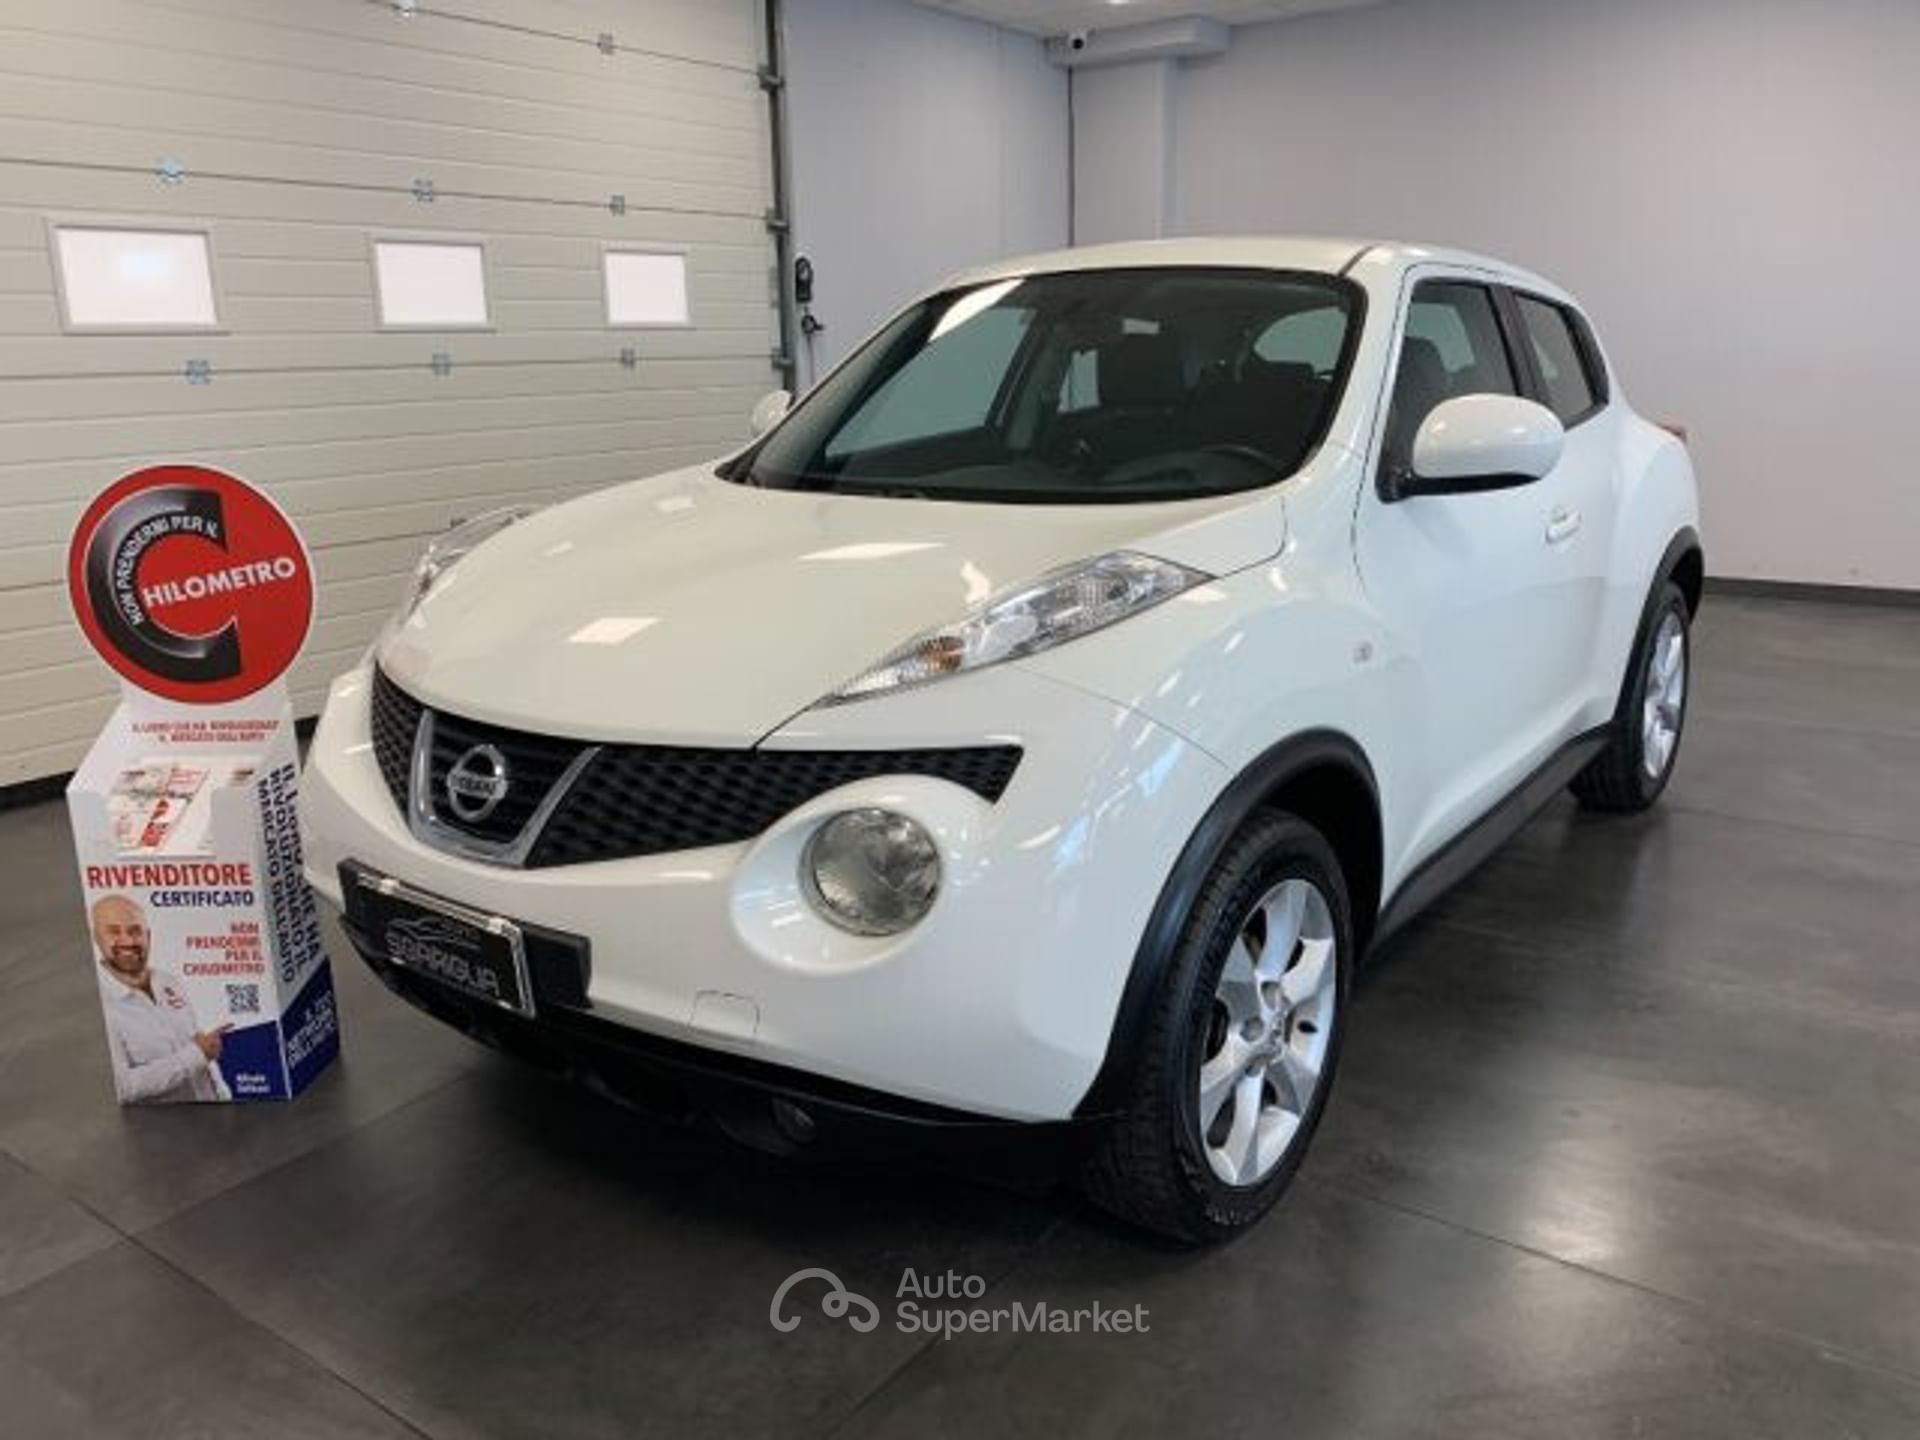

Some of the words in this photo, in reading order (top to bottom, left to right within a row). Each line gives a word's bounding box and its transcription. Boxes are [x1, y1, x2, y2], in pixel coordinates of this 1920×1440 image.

[170, 515, 202, 532] PER
[143, 556, 297, 608] HILOMETRO
[86, 863, 254, 889] RIVENDITORE
[150, 890, 255, 908] CERTIFICATO
